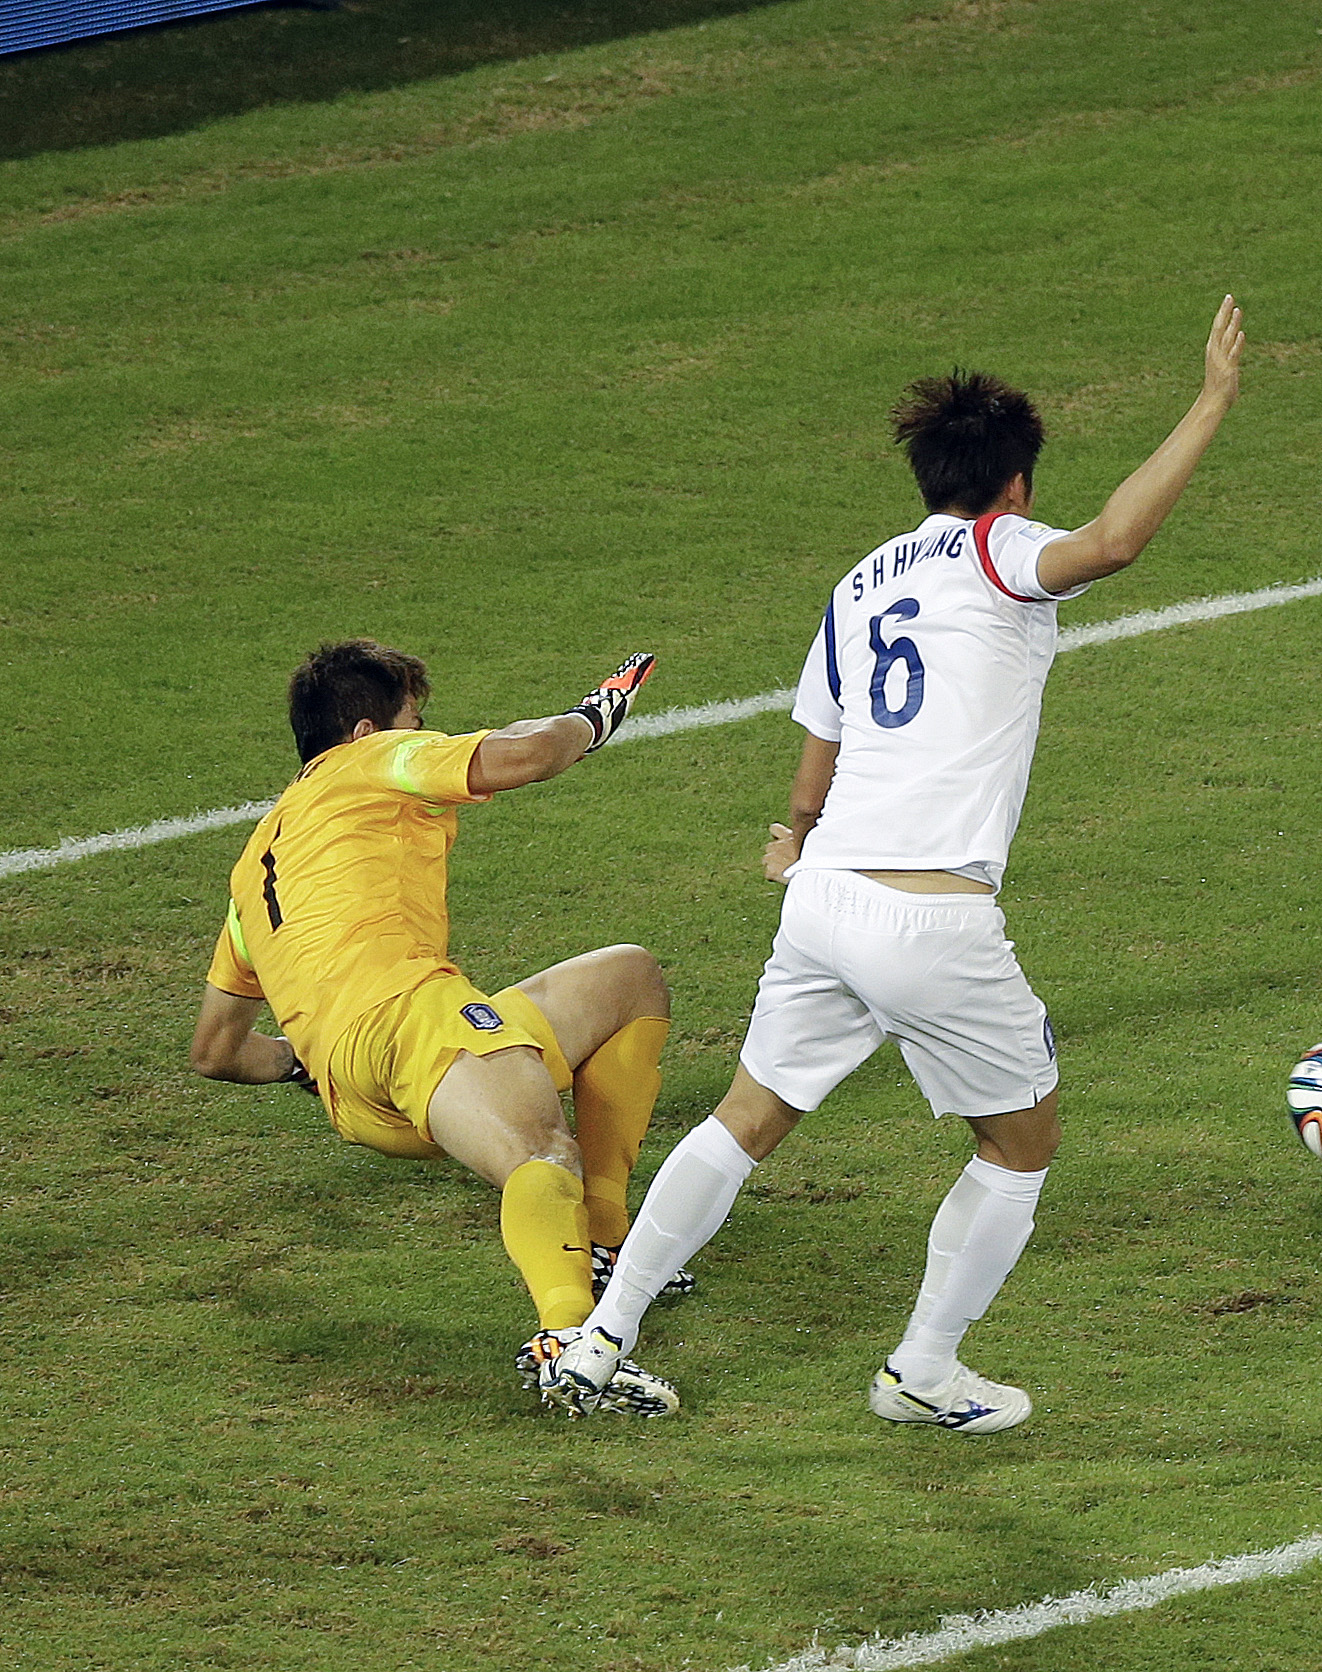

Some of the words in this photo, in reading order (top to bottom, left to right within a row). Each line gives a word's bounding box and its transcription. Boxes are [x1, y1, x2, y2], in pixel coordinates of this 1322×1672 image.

[852, 572, 864, 602] S
[873, 554, 884, 589] H
[869, 598, 924, 728] 6
[260, 816, 284, 934] 1
